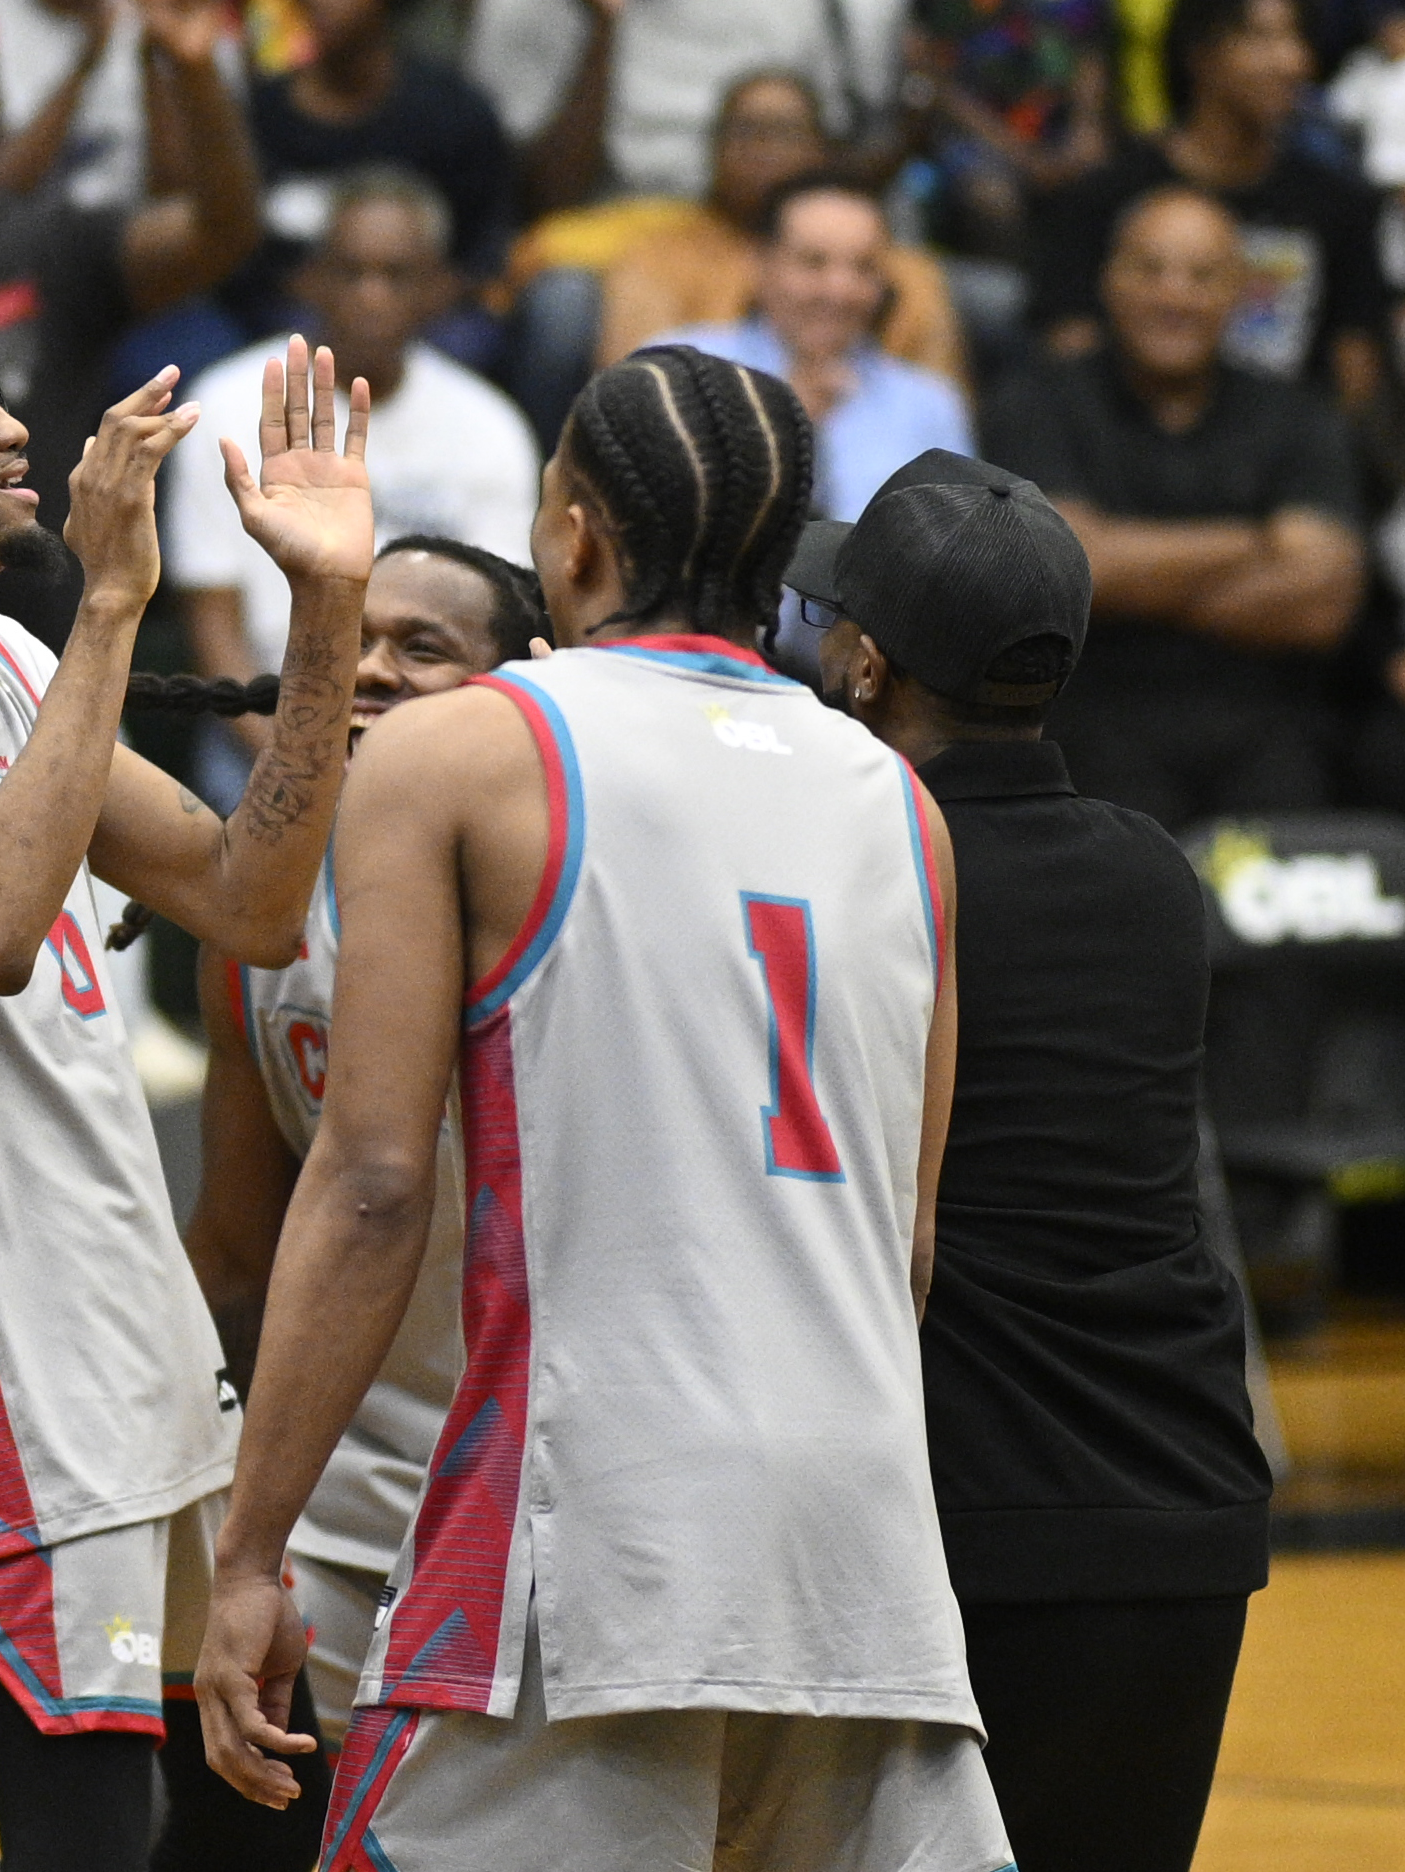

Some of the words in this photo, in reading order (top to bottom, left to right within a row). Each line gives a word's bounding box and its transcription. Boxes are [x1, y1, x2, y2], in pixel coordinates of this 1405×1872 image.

[712, 717, 793, 756] OBL
[1220, 852, 1405, 945] OBL
[44, 907, 108, 1022] 0
[738, 889, 847, 1184] 1
